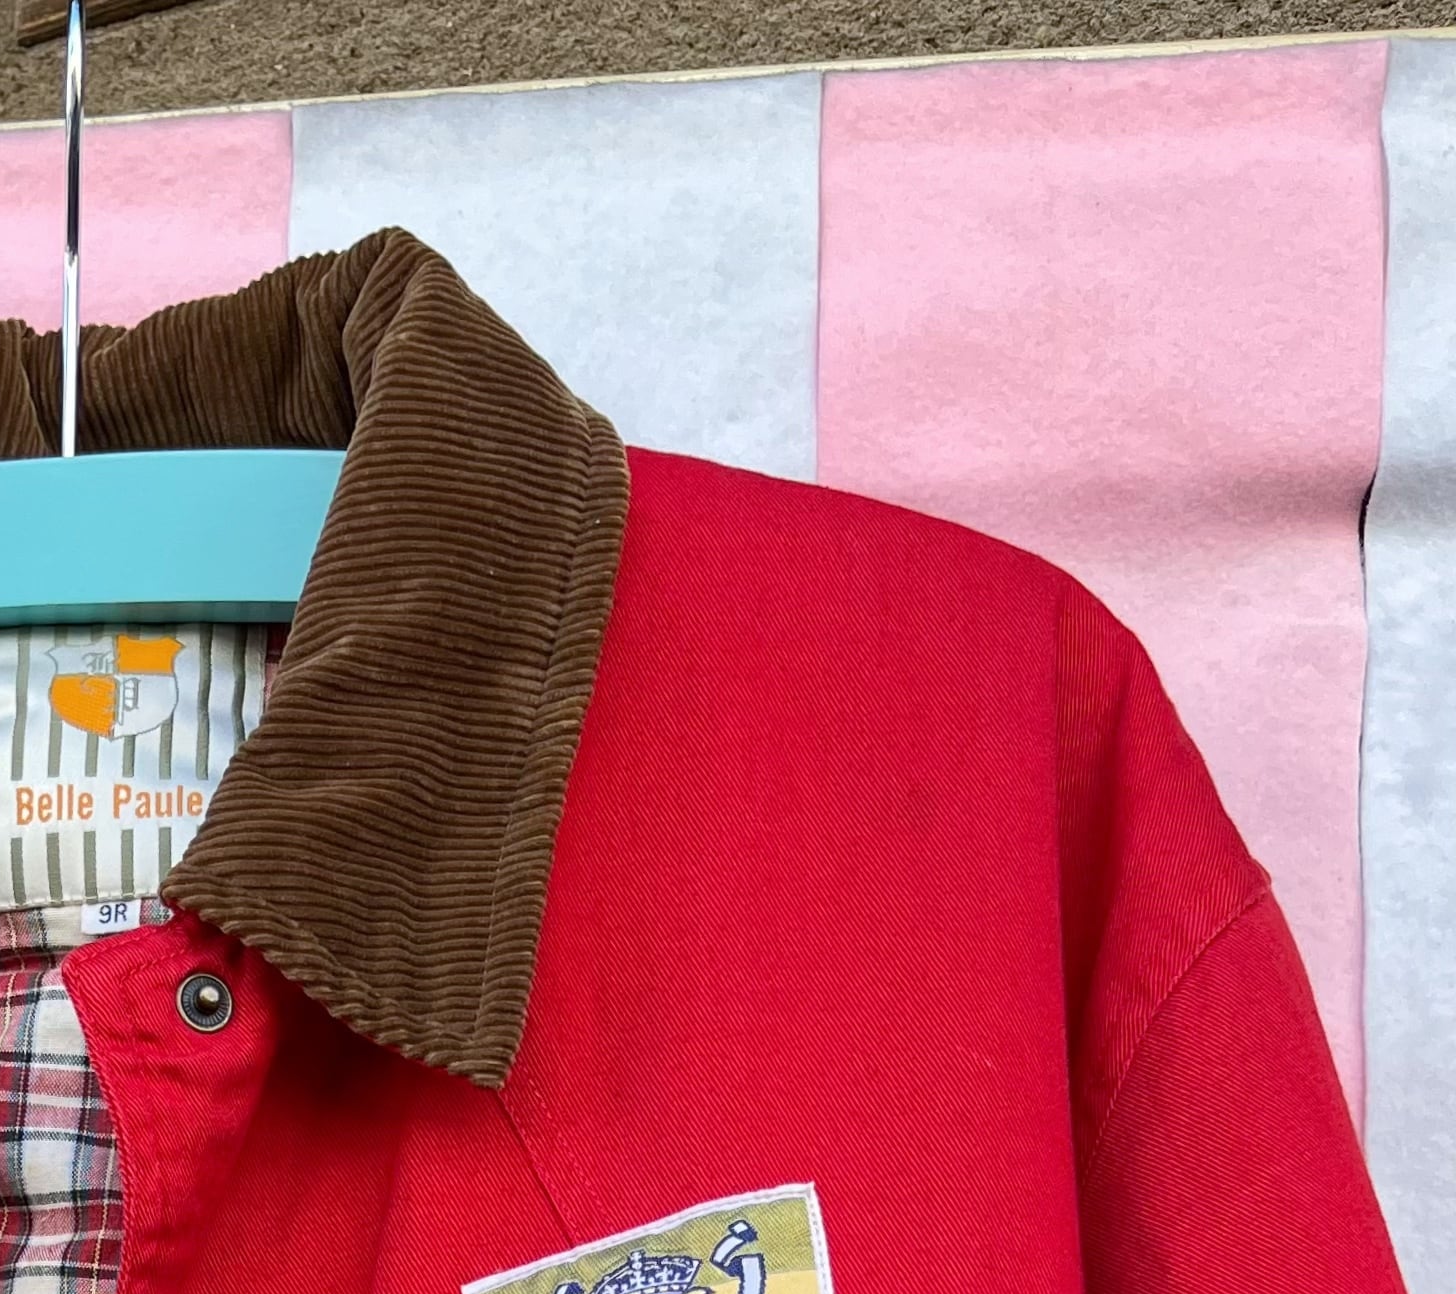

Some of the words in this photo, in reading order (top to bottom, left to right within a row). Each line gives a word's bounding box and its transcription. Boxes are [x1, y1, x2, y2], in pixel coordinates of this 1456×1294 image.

[15, 784, 94, 825] Belle
[112, 783, 204, 819] Paule
[97, 902, 128, 925] 9R
